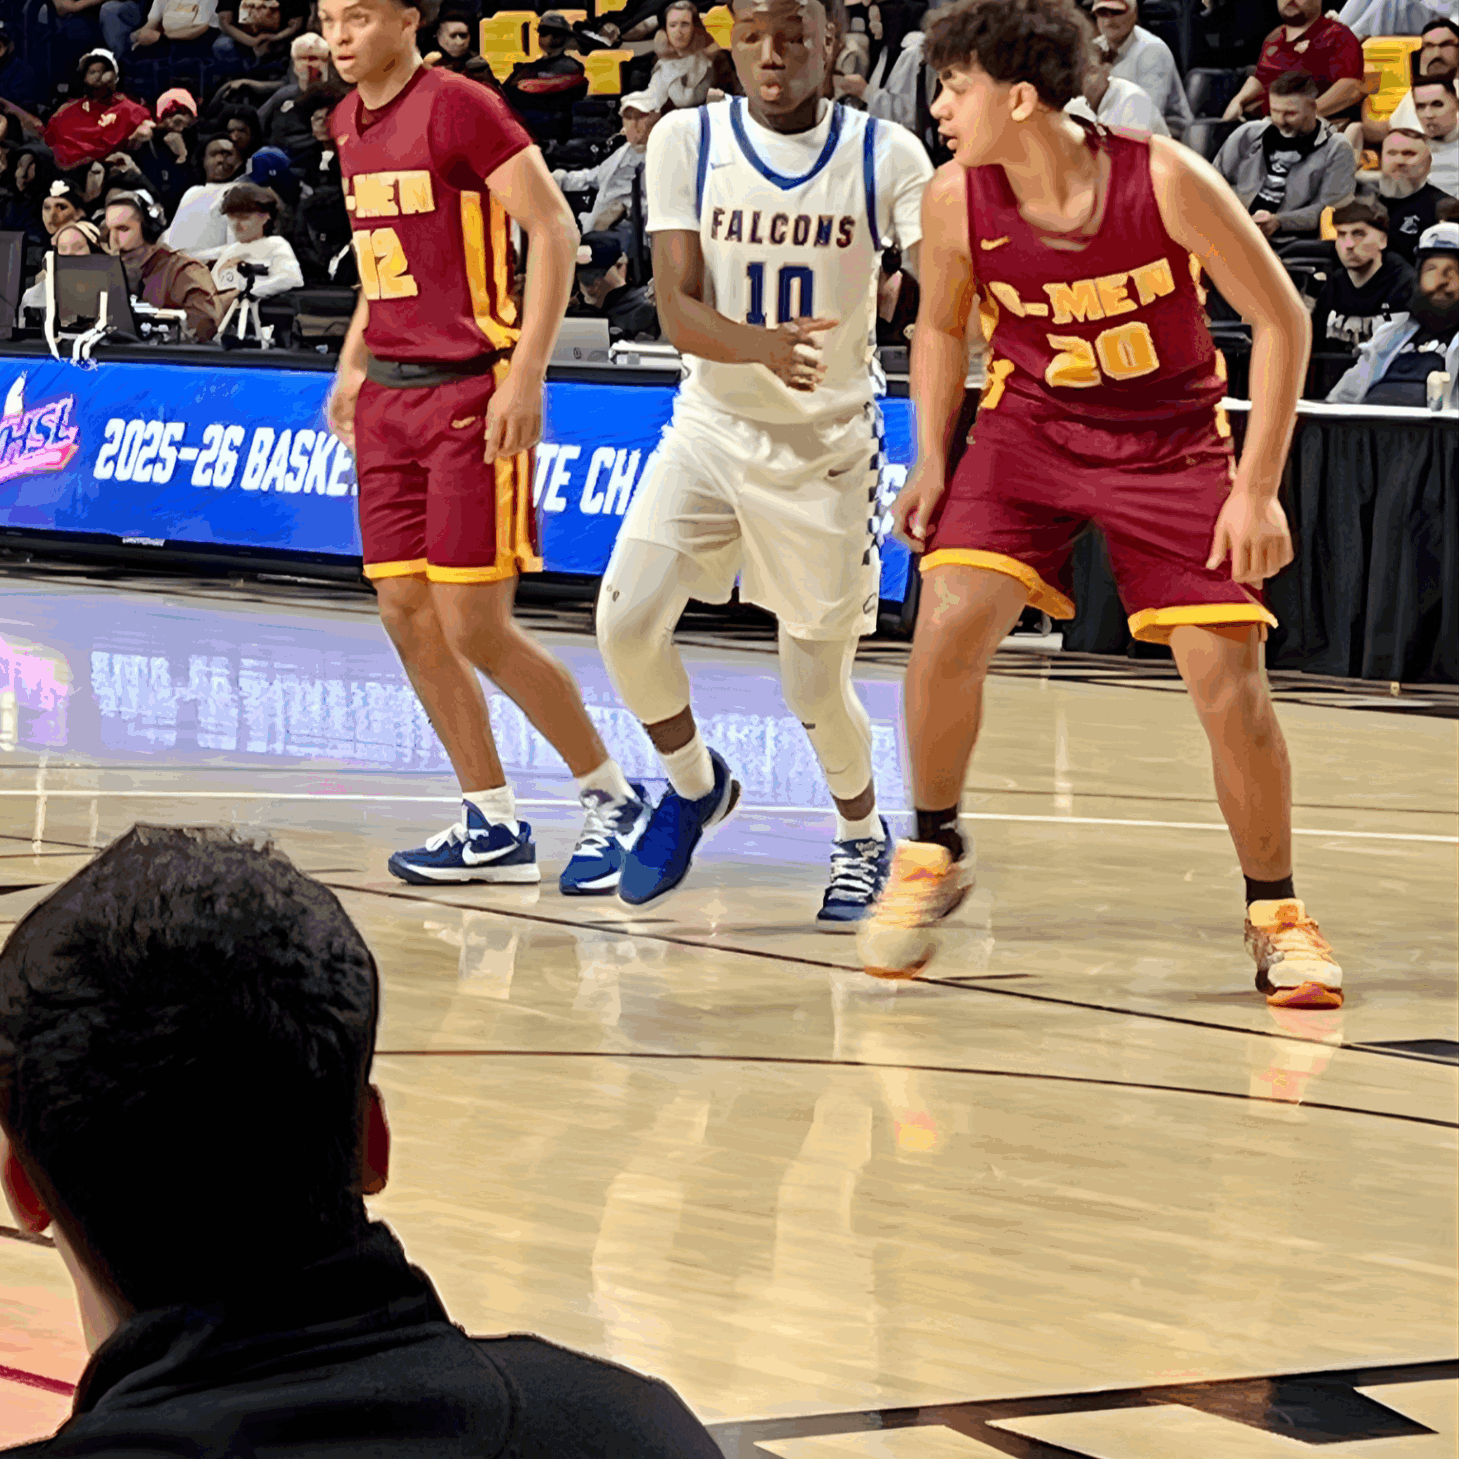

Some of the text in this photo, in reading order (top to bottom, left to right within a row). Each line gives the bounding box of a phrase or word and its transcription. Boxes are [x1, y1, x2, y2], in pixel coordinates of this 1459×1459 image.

[711, 207, 856, 248] FALCONS
[353, 228, 419, 300] 12
[746, 261, 814, 328] 10
[1045, 321, 1160, 388] 20
[93, 417, 245, 489] 2025-26
[240, 427, 360, 497] BASKE
